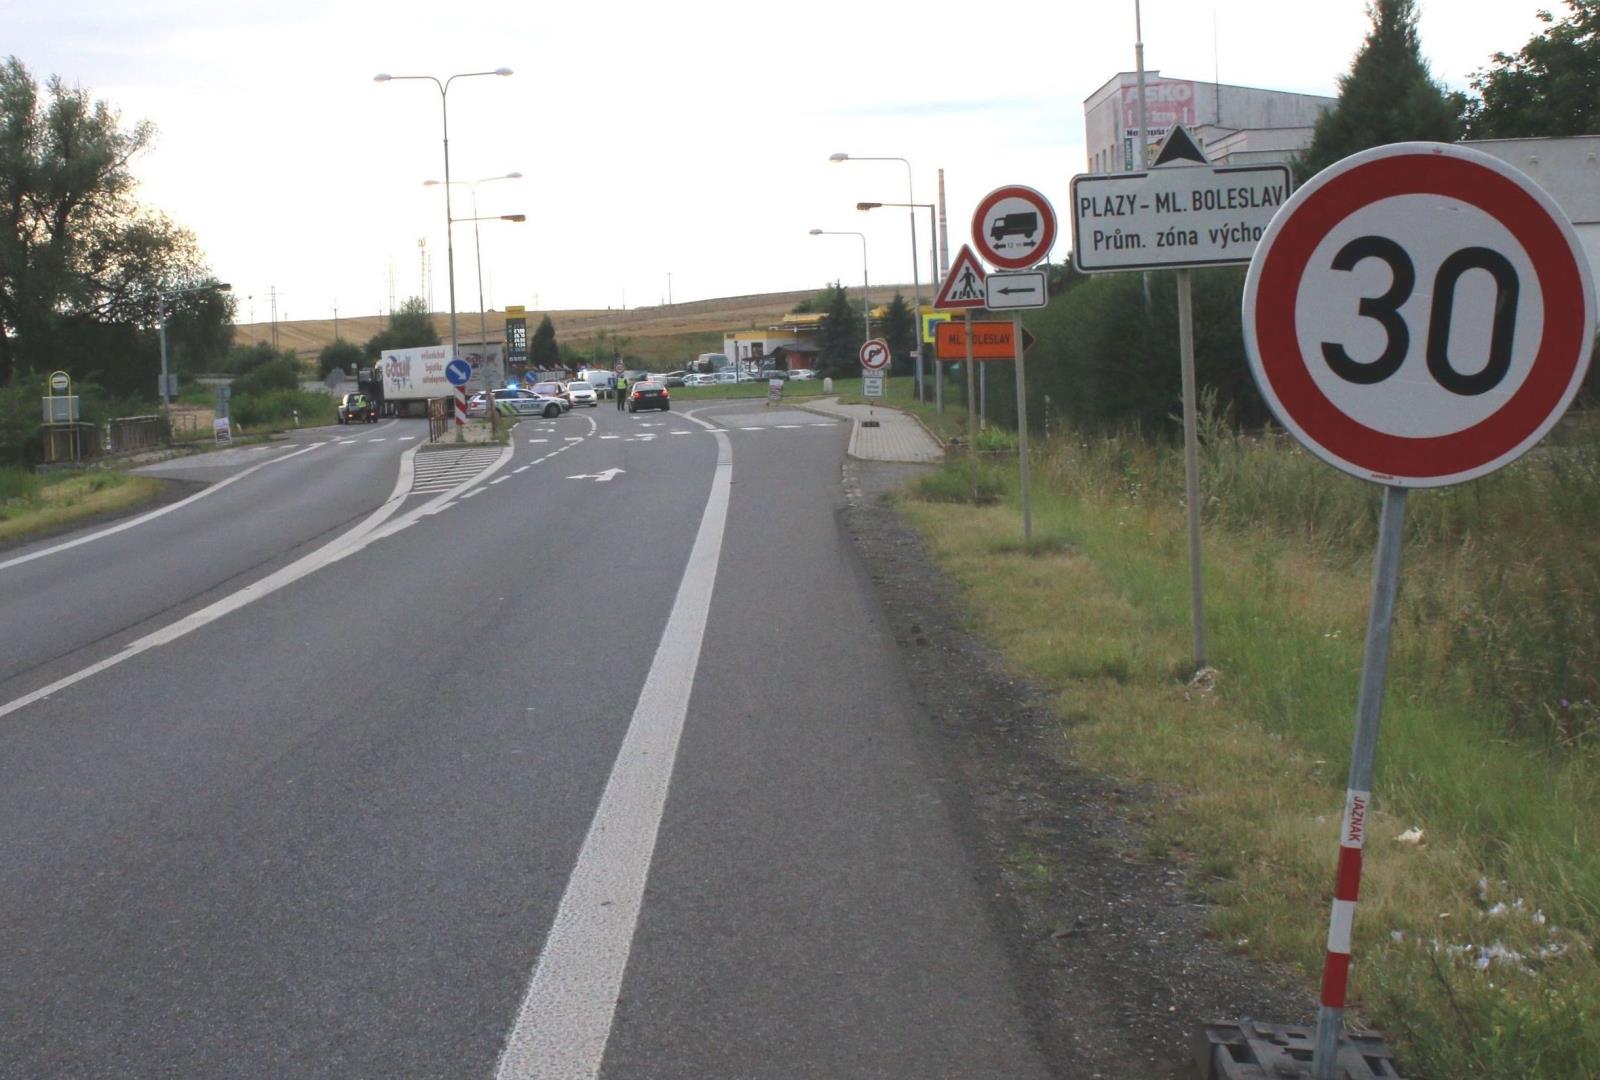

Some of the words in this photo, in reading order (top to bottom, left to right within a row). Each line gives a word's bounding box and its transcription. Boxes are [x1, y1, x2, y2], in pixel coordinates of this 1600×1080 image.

[1156, 191, 1187, 214] ML.
[1192, 185, 1282, 211] BOLESLAV
[1093, 228, 1146, 251] Prům.
[1156, 225, 1198, 247] zóna
[1208, 221, 1267, 249] výcho
[1320, 234, 1520, 397] 30
[967, 333, 1010, 345] OLESLAV
